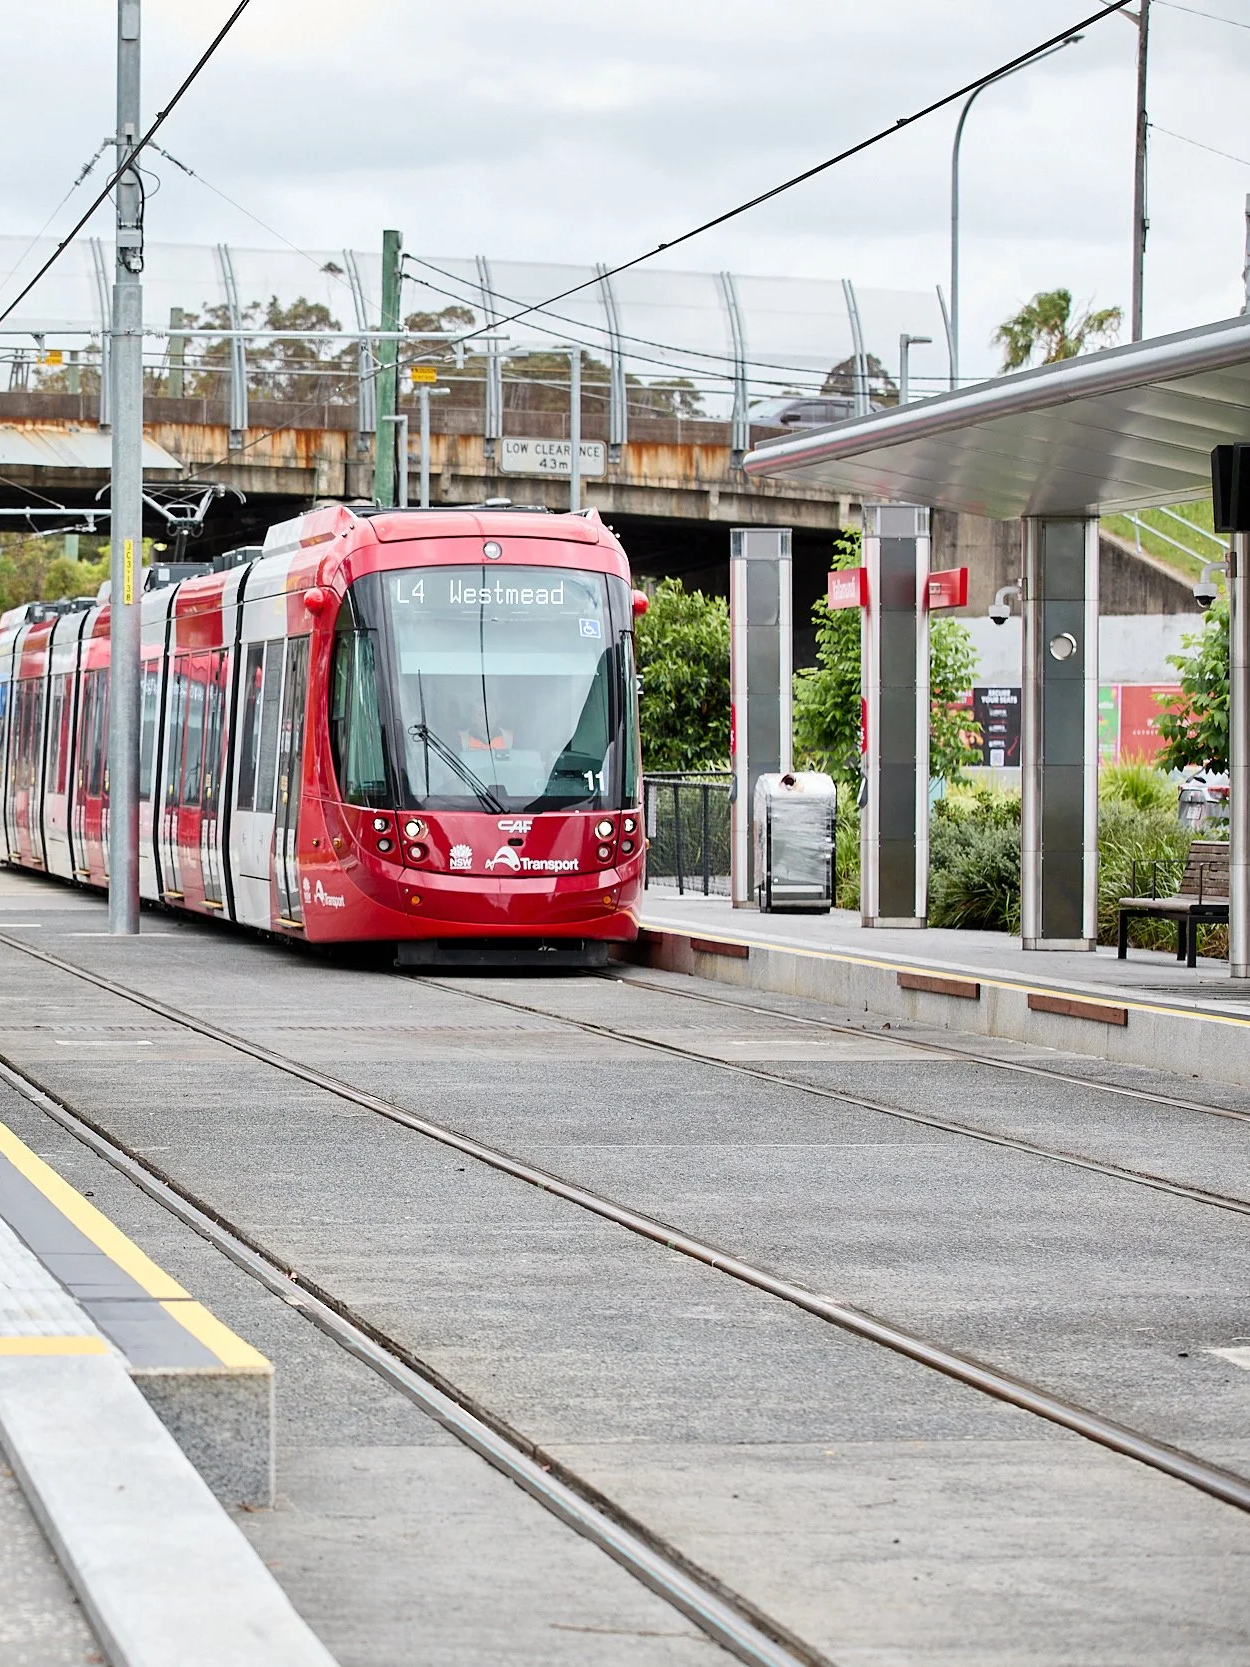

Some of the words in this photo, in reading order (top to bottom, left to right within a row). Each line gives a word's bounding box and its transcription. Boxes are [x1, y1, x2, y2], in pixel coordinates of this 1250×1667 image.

[506, 443, 529, 454] LOW
[534, 443, 600, 458] CLEARNCE
[396, 578, 425, 604] L4
[449, 579, 564, 605] Westmead
[583, 770, 605, 792] 11
[497, 820, 533, 834] CAF
[449, 857, 473, 868] NSW
[520, 857, 579, 872] Transport
